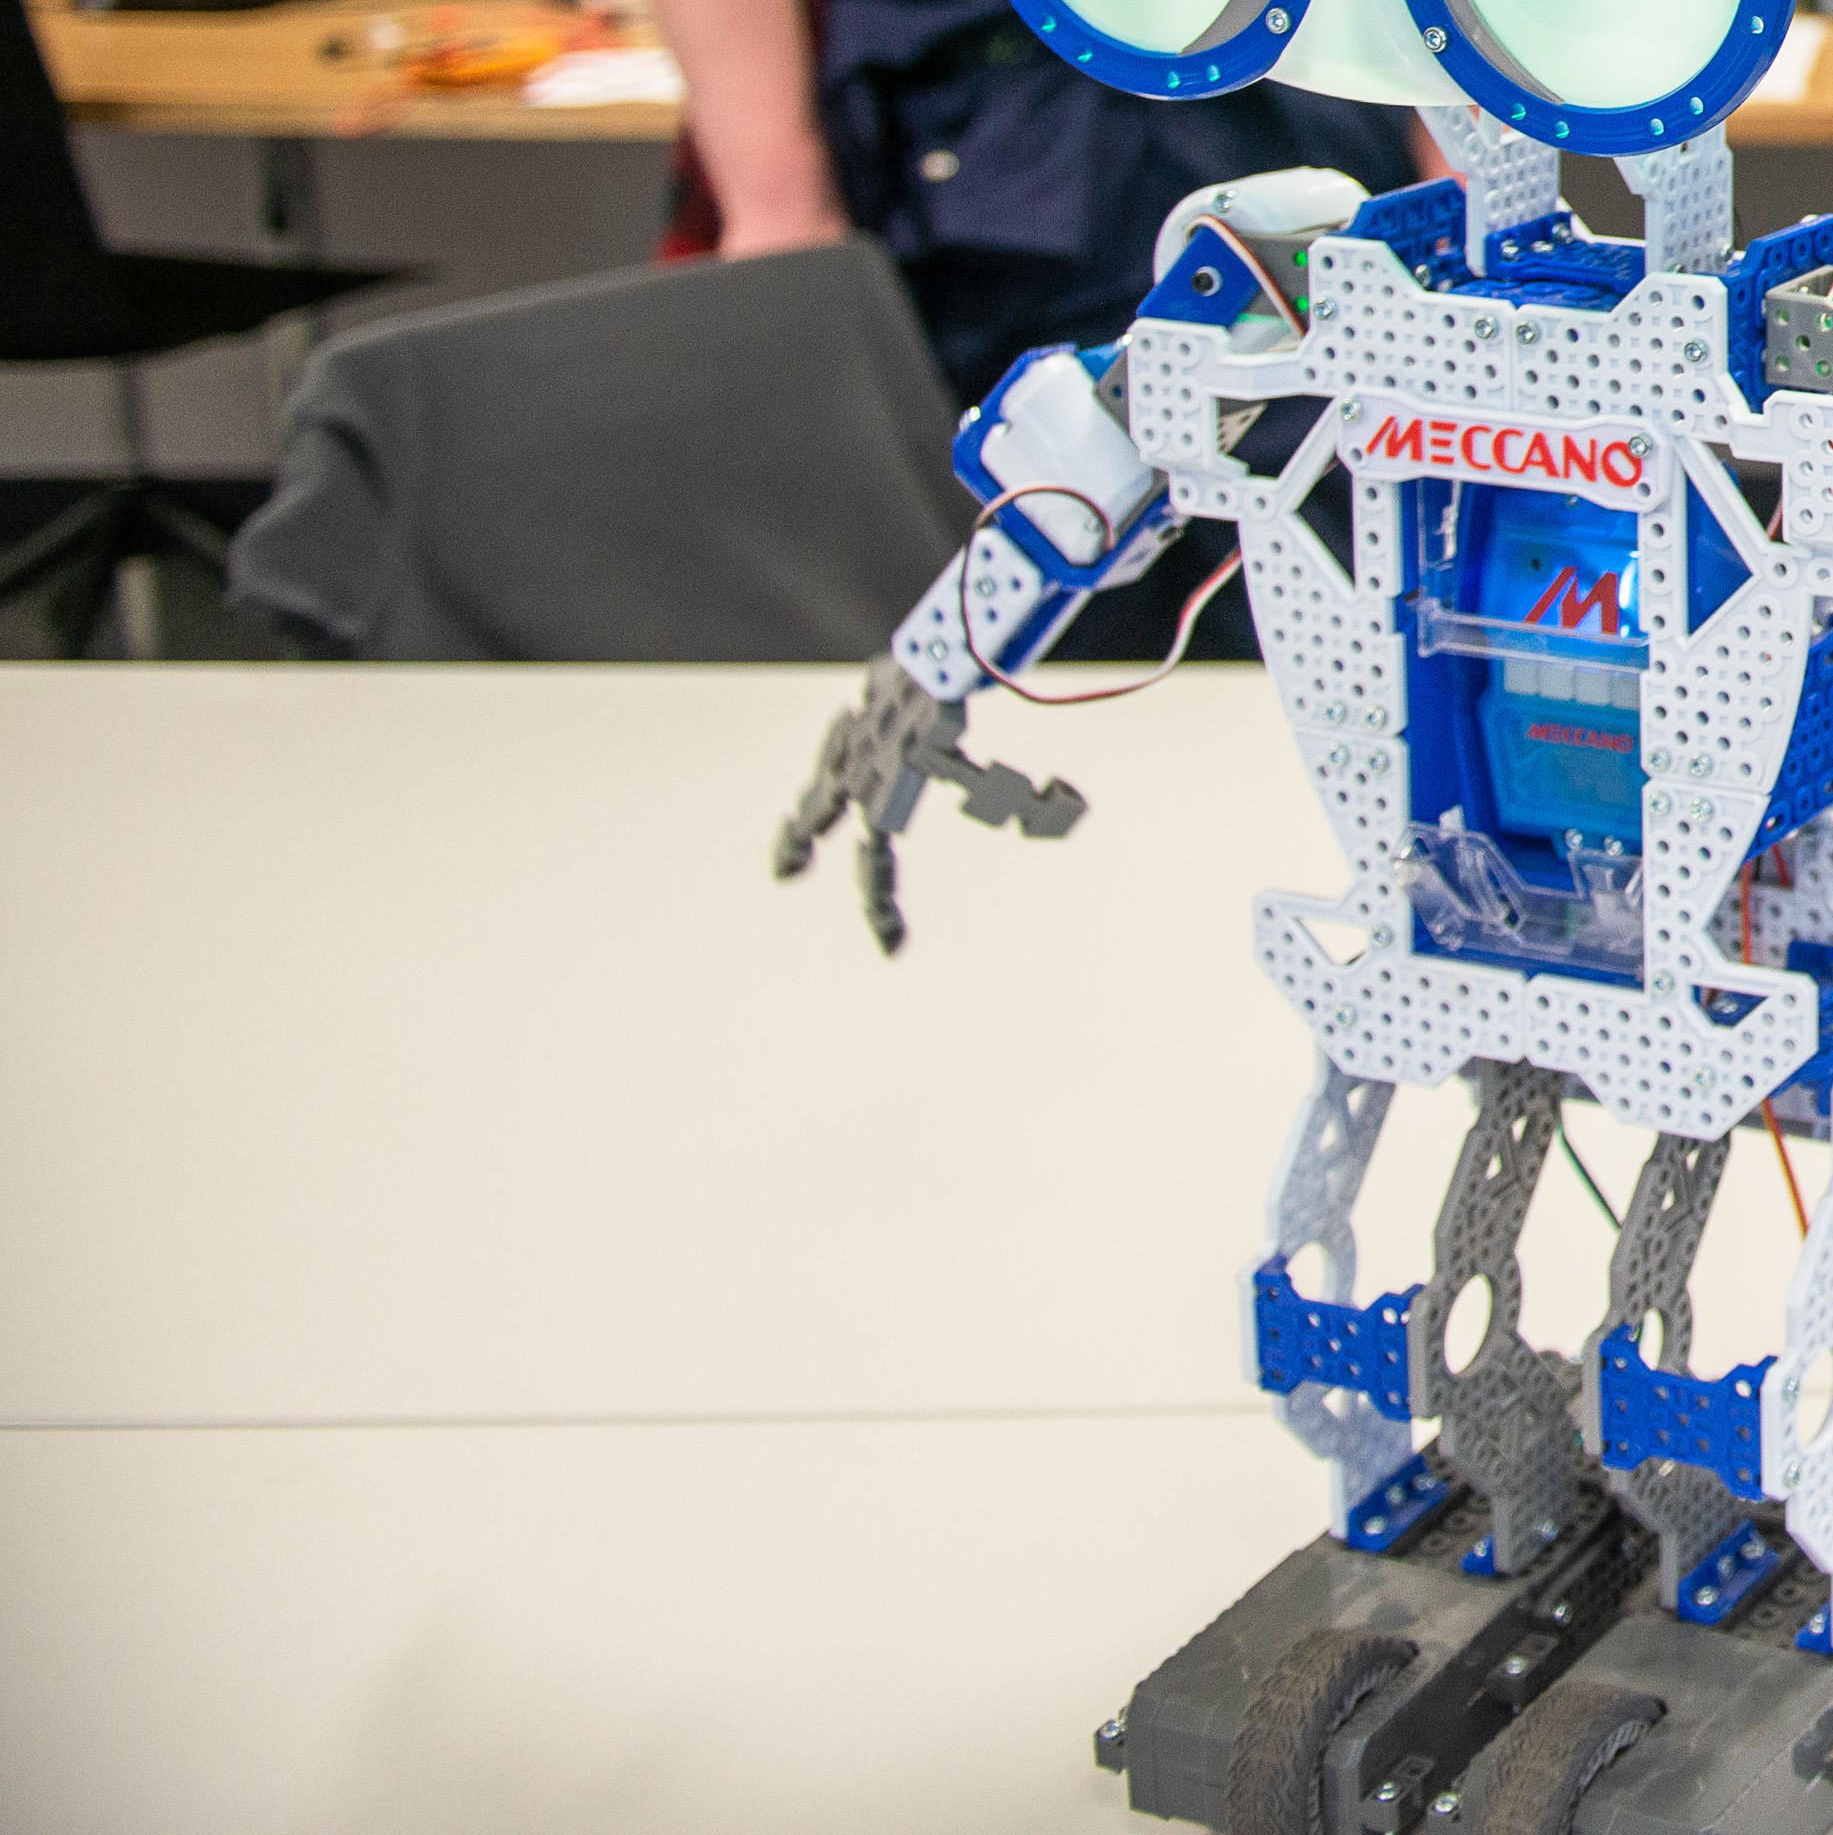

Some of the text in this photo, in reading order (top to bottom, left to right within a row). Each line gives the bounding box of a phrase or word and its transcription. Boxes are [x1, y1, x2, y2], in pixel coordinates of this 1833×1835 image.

[1366, 416, 1643, 489] MECCANO
[1523, 565, 1620, 636] M
[1524, 722, 1635, 754] MECCANO
